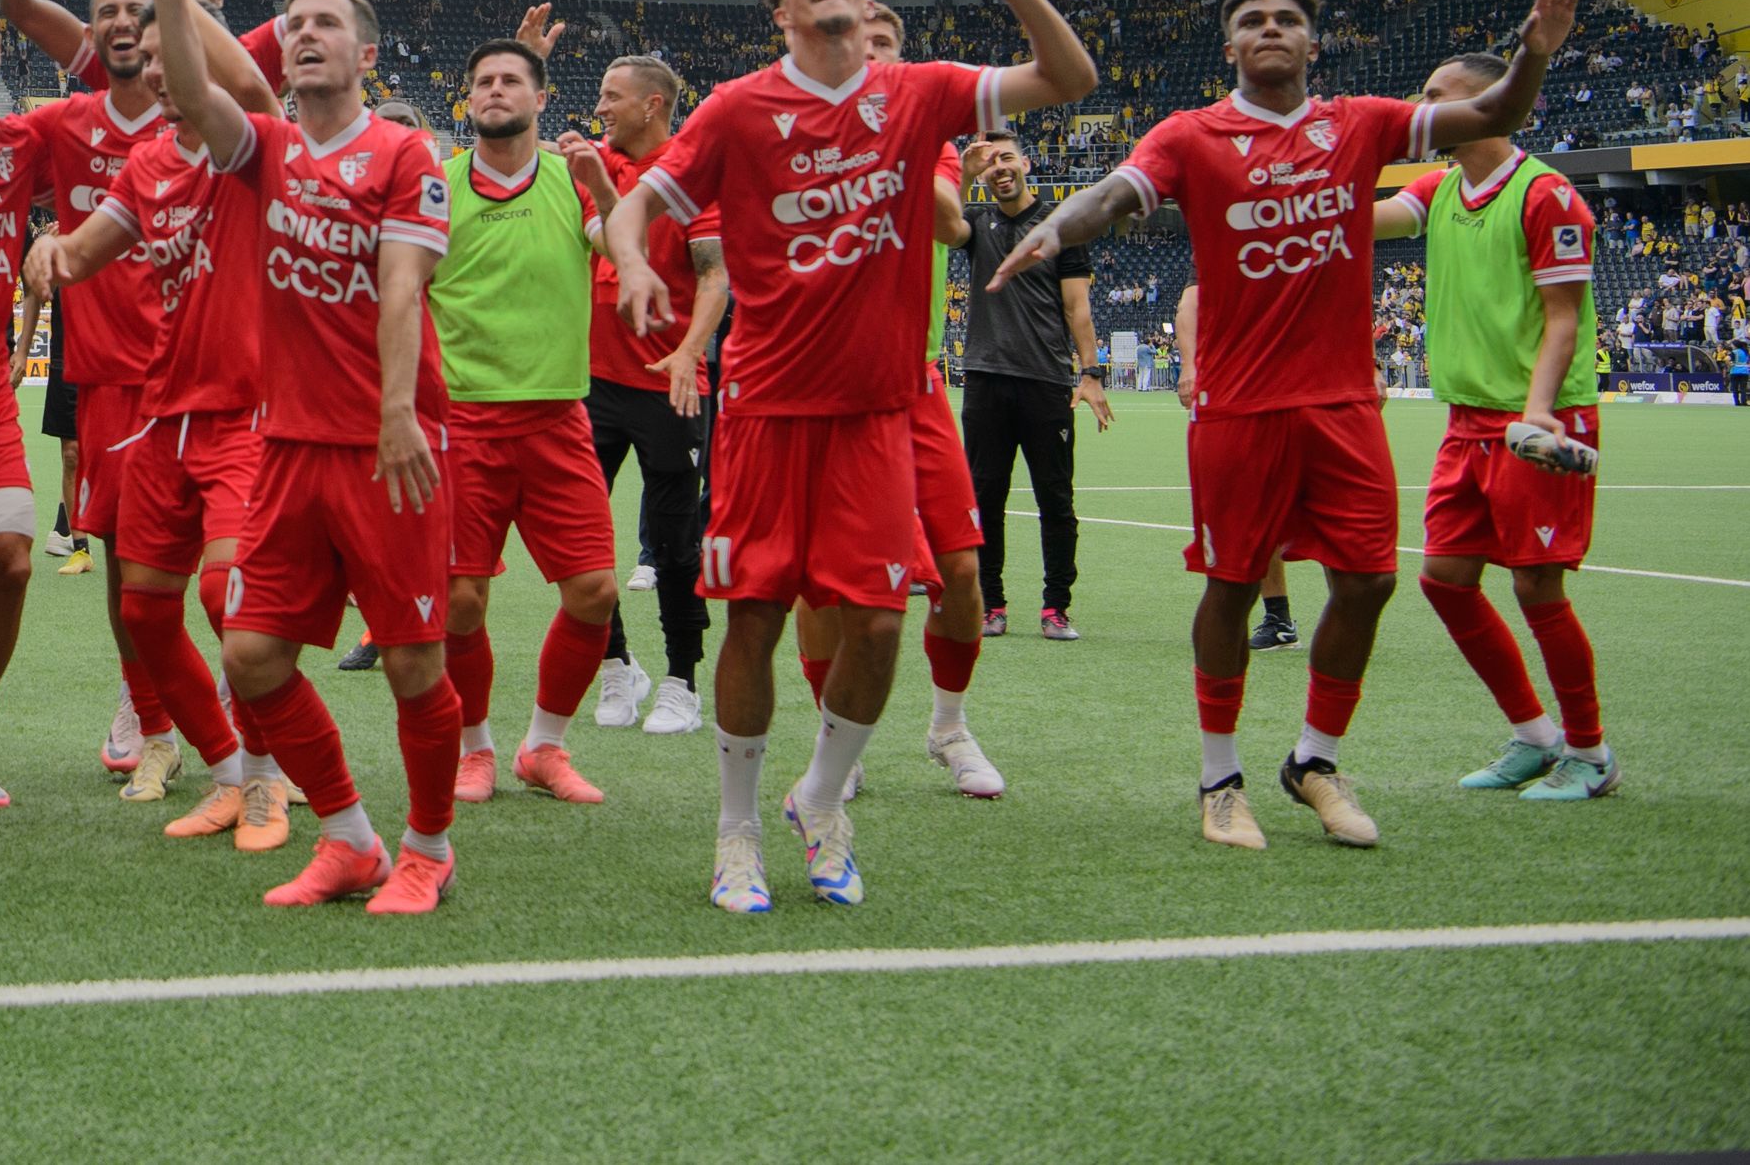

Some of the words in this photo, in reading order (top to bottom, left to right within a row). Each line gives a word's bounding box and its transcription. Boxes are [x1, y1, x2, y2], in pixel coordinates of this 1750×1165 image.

[1080, 121, 1113, 135] D15
[1254, 182, 1355, 228] OIKEN
[1630, 380, 1656, 391] wefox
[1692, 380, 1720, 391] wefox
[701, 536, 732, 588] 11
